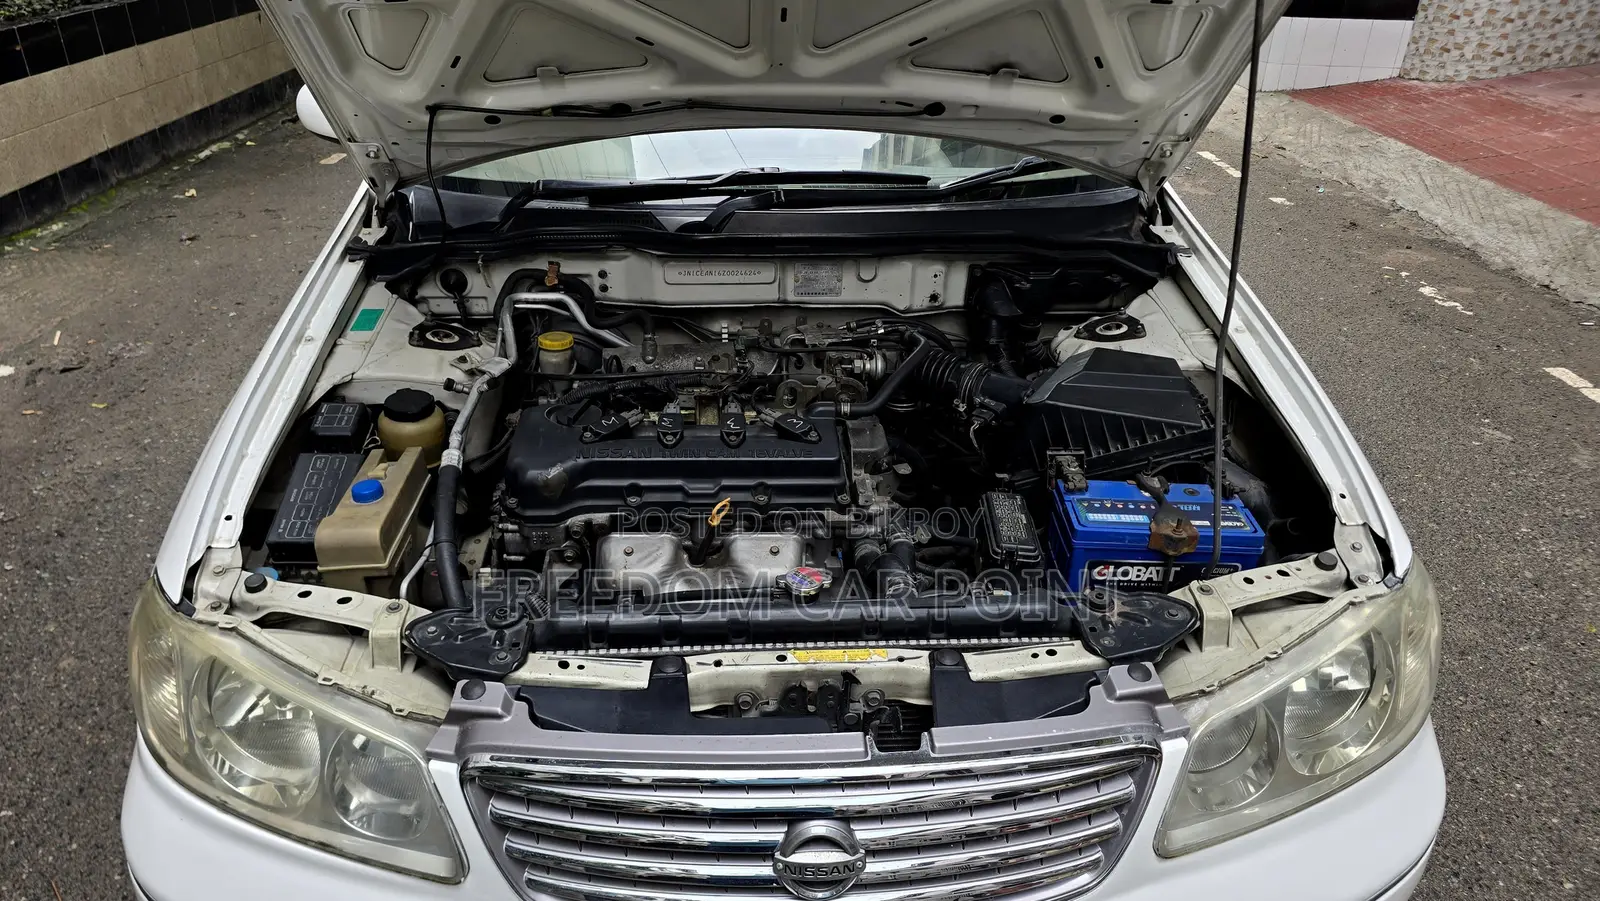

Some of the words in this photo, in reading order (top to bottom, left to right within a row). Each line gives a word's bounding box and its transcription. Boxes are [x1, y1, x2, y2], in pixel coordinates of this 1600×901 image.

[575, 447, 651, 459] NISSAN
[659, 448, 701, 459] TWIN
[704, 448, 741, 459] CAM
[1092, 565, 1181, 582] GLOBATT
[784, 862, 856, 878] NISSAN
